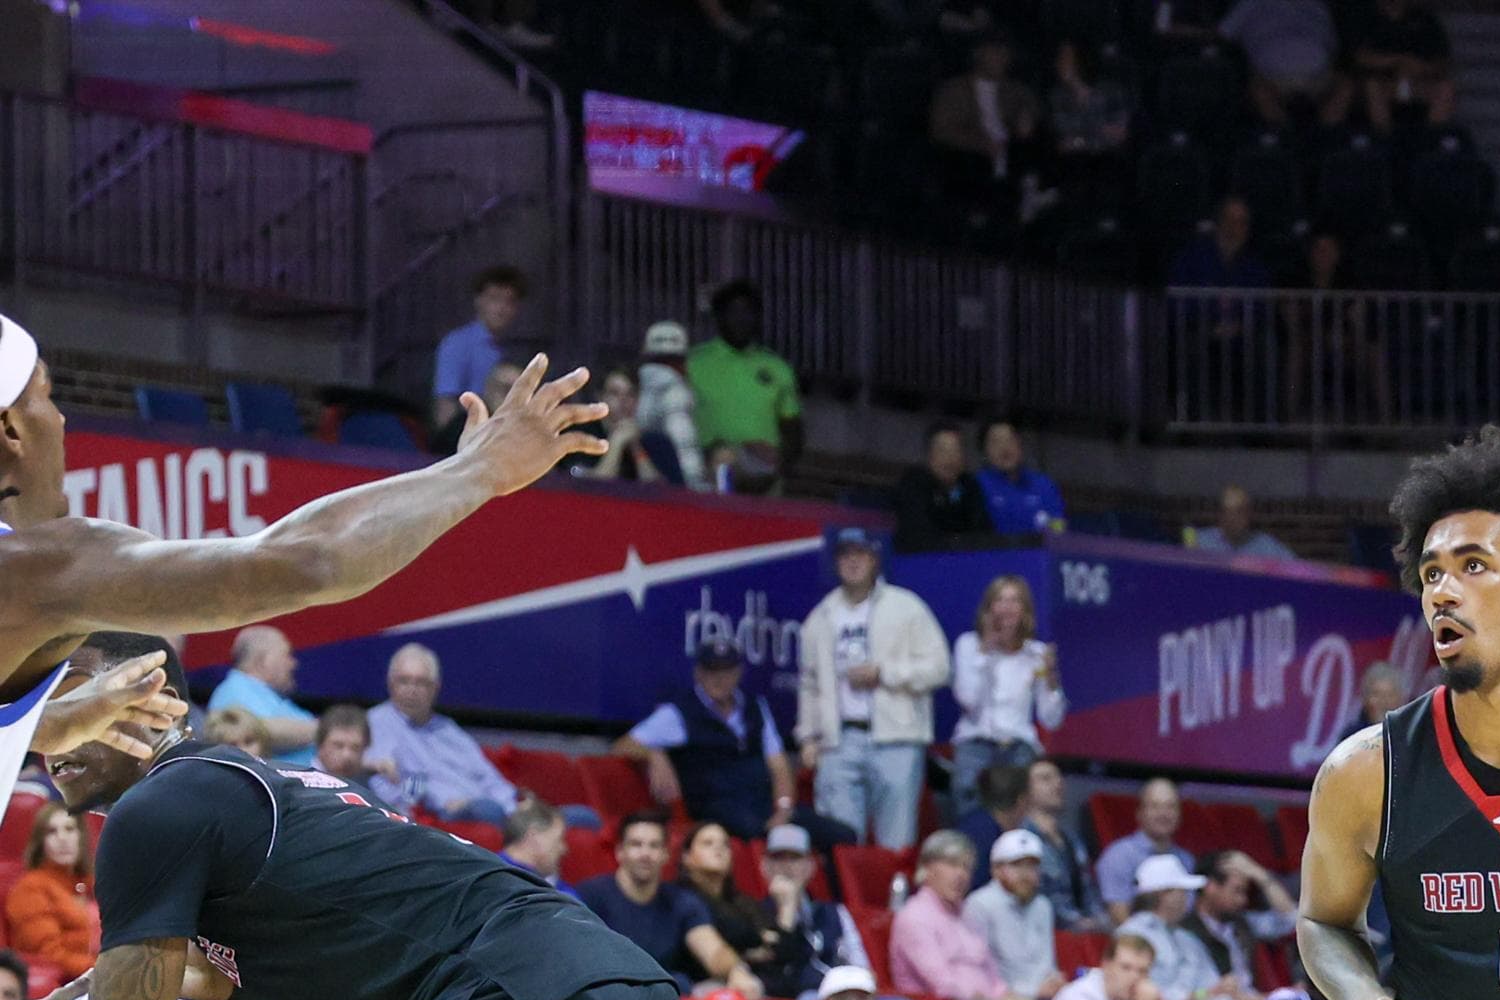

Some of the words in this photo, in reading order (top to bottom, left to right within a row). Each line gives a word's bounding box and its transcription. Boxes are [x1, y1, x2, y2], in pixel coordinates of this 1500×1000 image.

[1060, 560, 1110, 605] 106
[1158, 614, 1246, 738] PONY
[1252, 604, 1296, 711] UP
[1420, 871, 1485, 913] RED
